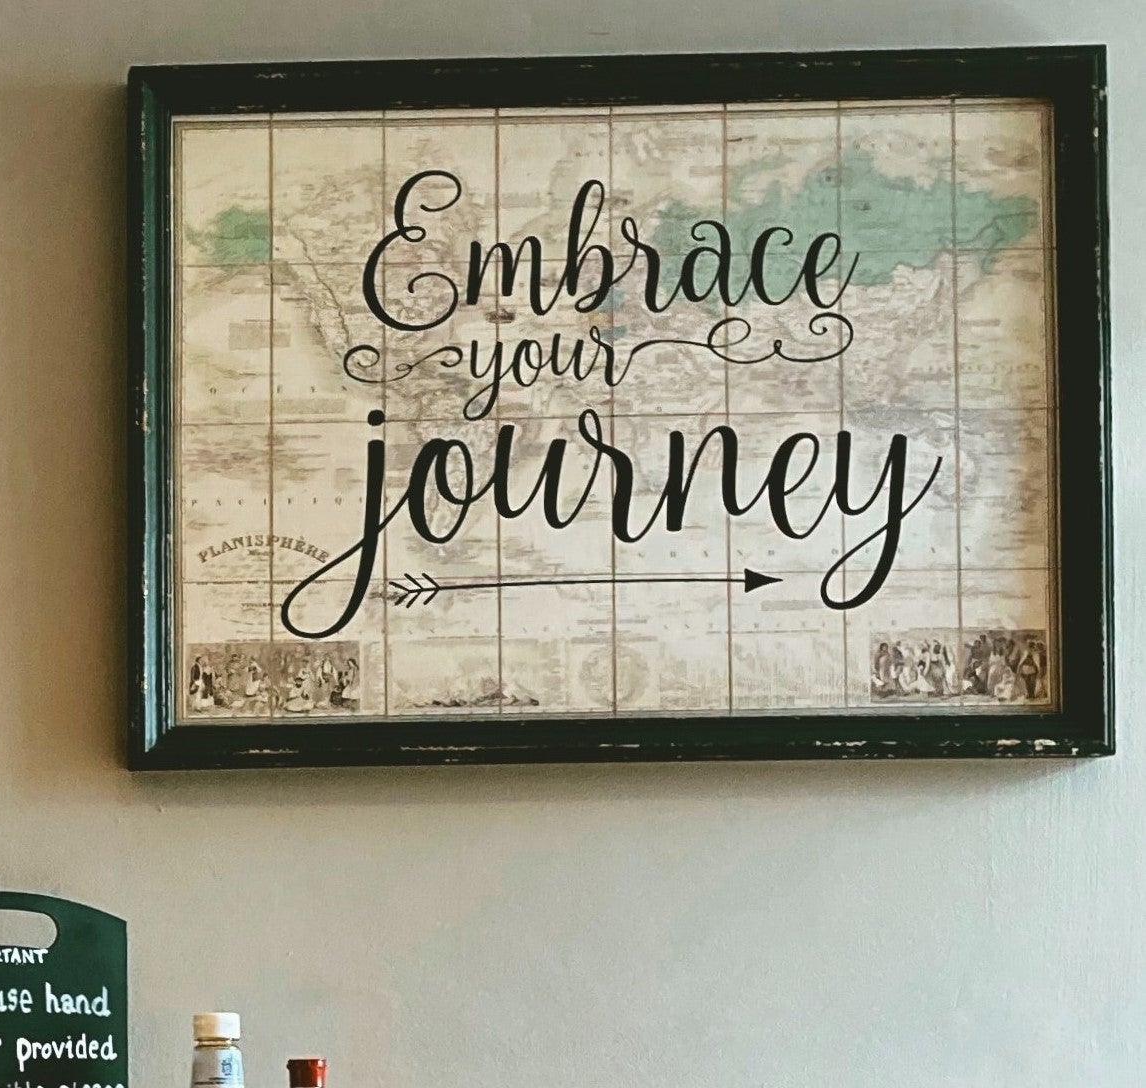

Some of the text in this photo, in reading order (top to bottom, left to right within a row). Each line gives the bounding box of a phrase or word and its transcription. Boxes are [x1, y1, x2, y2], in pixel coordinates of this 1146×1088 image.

[364, 170, 859, 332] Embrace
[281, 408, 942, 639] journey
[44, 981, 112, 1018] hand
[16, 1033, 118, 1073] provided
